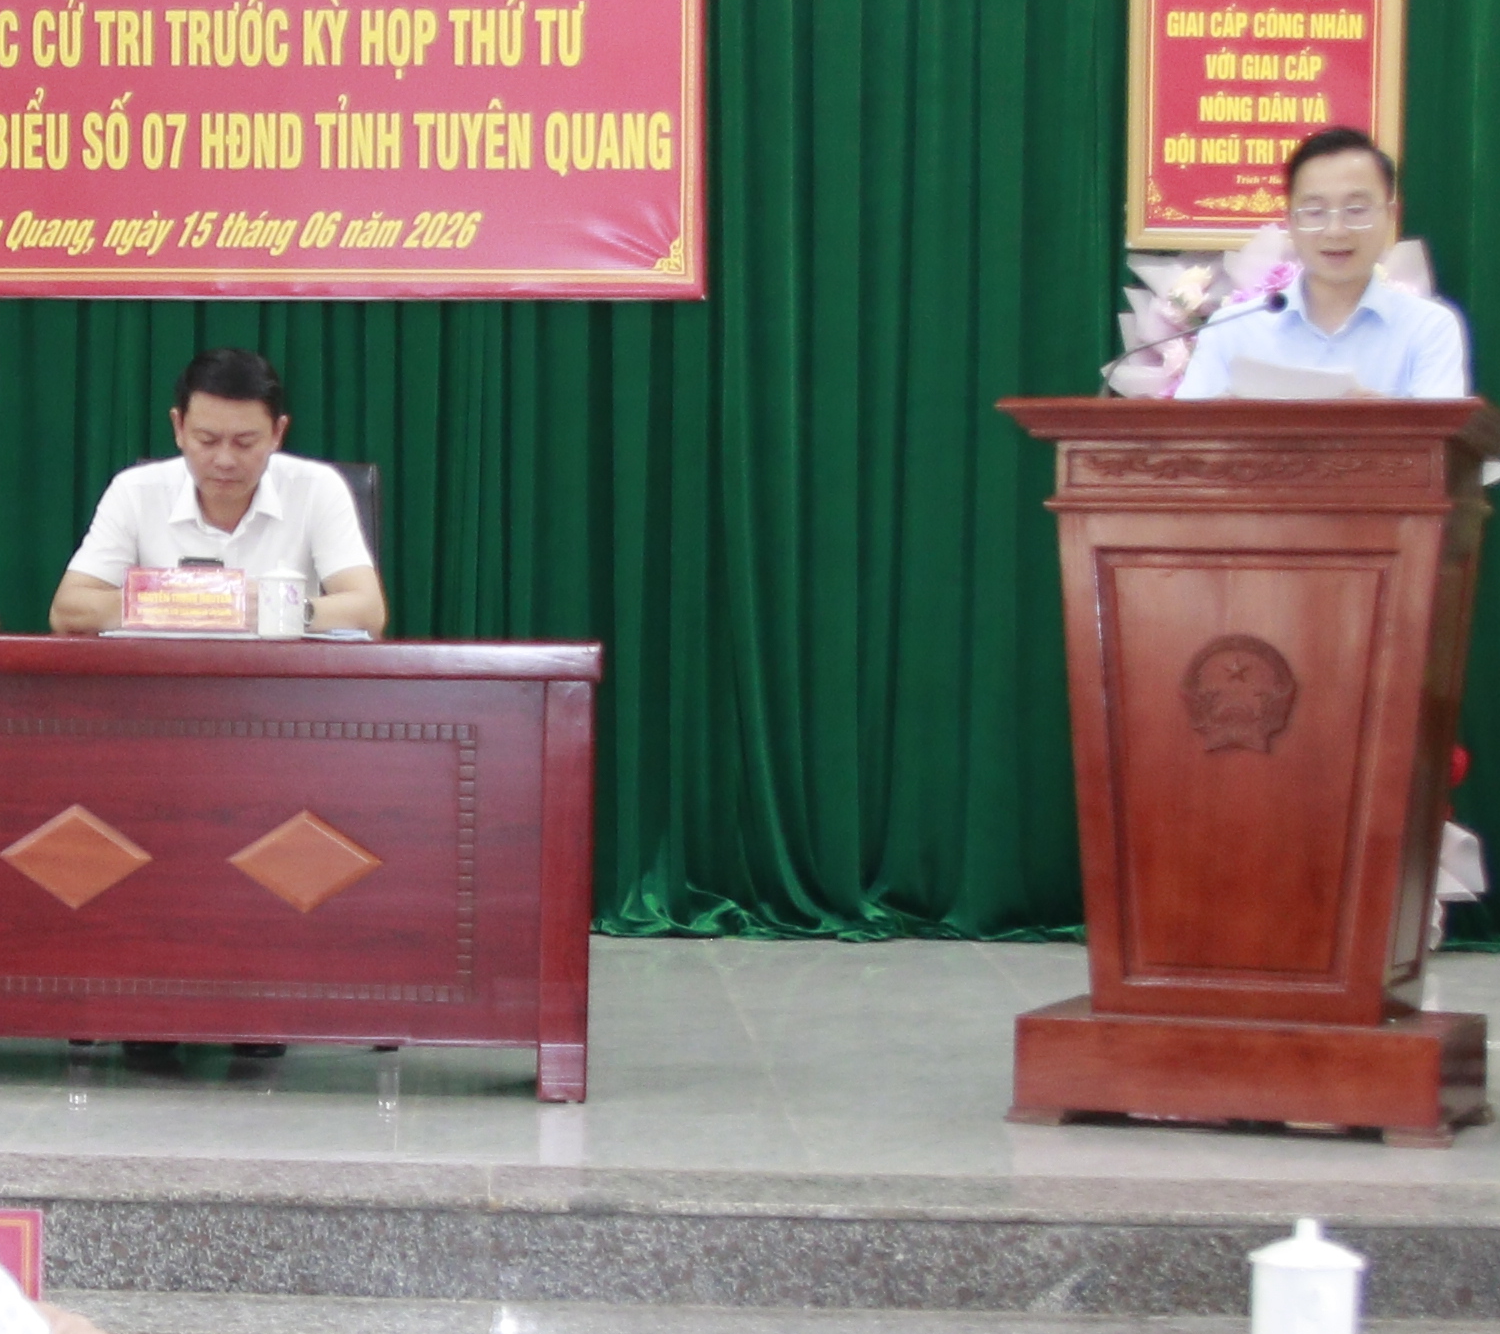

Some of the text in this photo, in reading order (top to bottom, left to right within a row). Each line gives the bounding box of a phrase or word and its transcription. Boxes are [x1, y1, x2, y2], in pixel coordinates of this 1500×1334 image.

[1167, 4, 1363, 39] GIAI CẤP CÔNG NHÂN
[94, 10, 153, 67] TRI
[360, 7, 438, 80] HỌP
[534, 0, 585, 67] TƯ
[1206, 47, 1323, 81] VỚI GIAI CẤP
[1200, 92, 1326, 122] NÔNG DÂN VÀ
[82, 91, 133, 170] SỐ
[142, 112, 188, 170] 07
[201, 112, 303, 170] HĐND
[314, 93, 401, 170] TỈNH
[413, 98, 532, 171] TUYÊN
[545, 111, 672, 177] QUANG
[1164, 133, 1197, 168] ĐỘI
[1201, 134, 1240, 163] NGŨ
[1246, 139, 1274, 164] TRI
[5, 211, 96, 255] Quang,
[103, 211, 174, 255] ngày
[177, 214, 217, 248] 15
[215, 211, 297, 255] tháng
[298, 211, 339, 248] 06
[339, 211, 403, 248] năm
[402, 211, 482, 248] 2026
